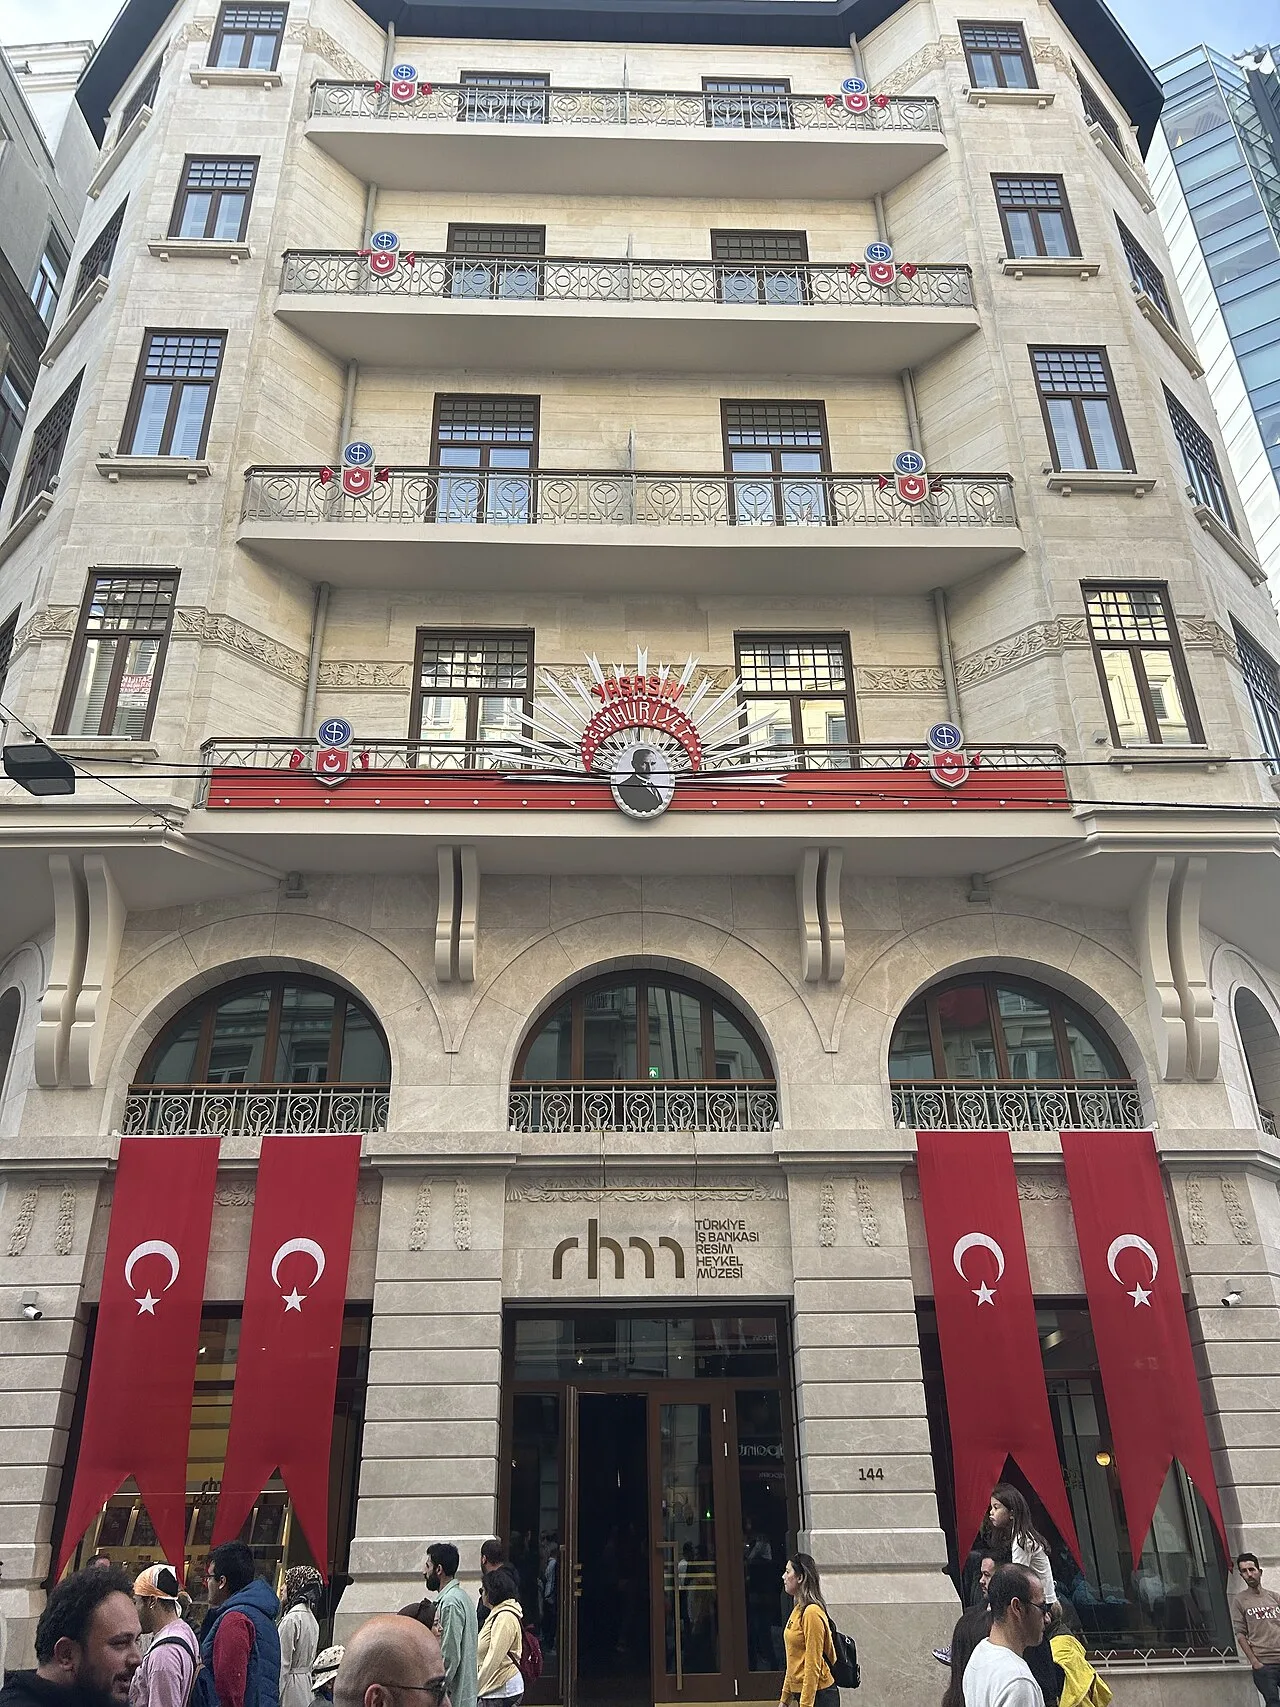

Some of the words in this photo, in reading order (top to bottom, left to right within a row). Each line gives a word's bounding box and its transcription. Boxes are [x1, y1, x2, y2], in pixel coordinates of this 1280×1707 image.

[591, 675, 685, 704] YAŞASIN
[589, 701, 692, 740] CUMHURİYET
[695, 1218, 745, 1230] TÜRKİYE
[695, 1230, 706, 1244] İŞ
[708, 1231, 759, 1242] BANKASI
[696, 1242, 733, 1254] RESİM
[696, 1255, 743, 1267] HEYKEL
[697, 1266, 743, 1279] MÜZESİ
[858, 1467, 884, 1480] 144
